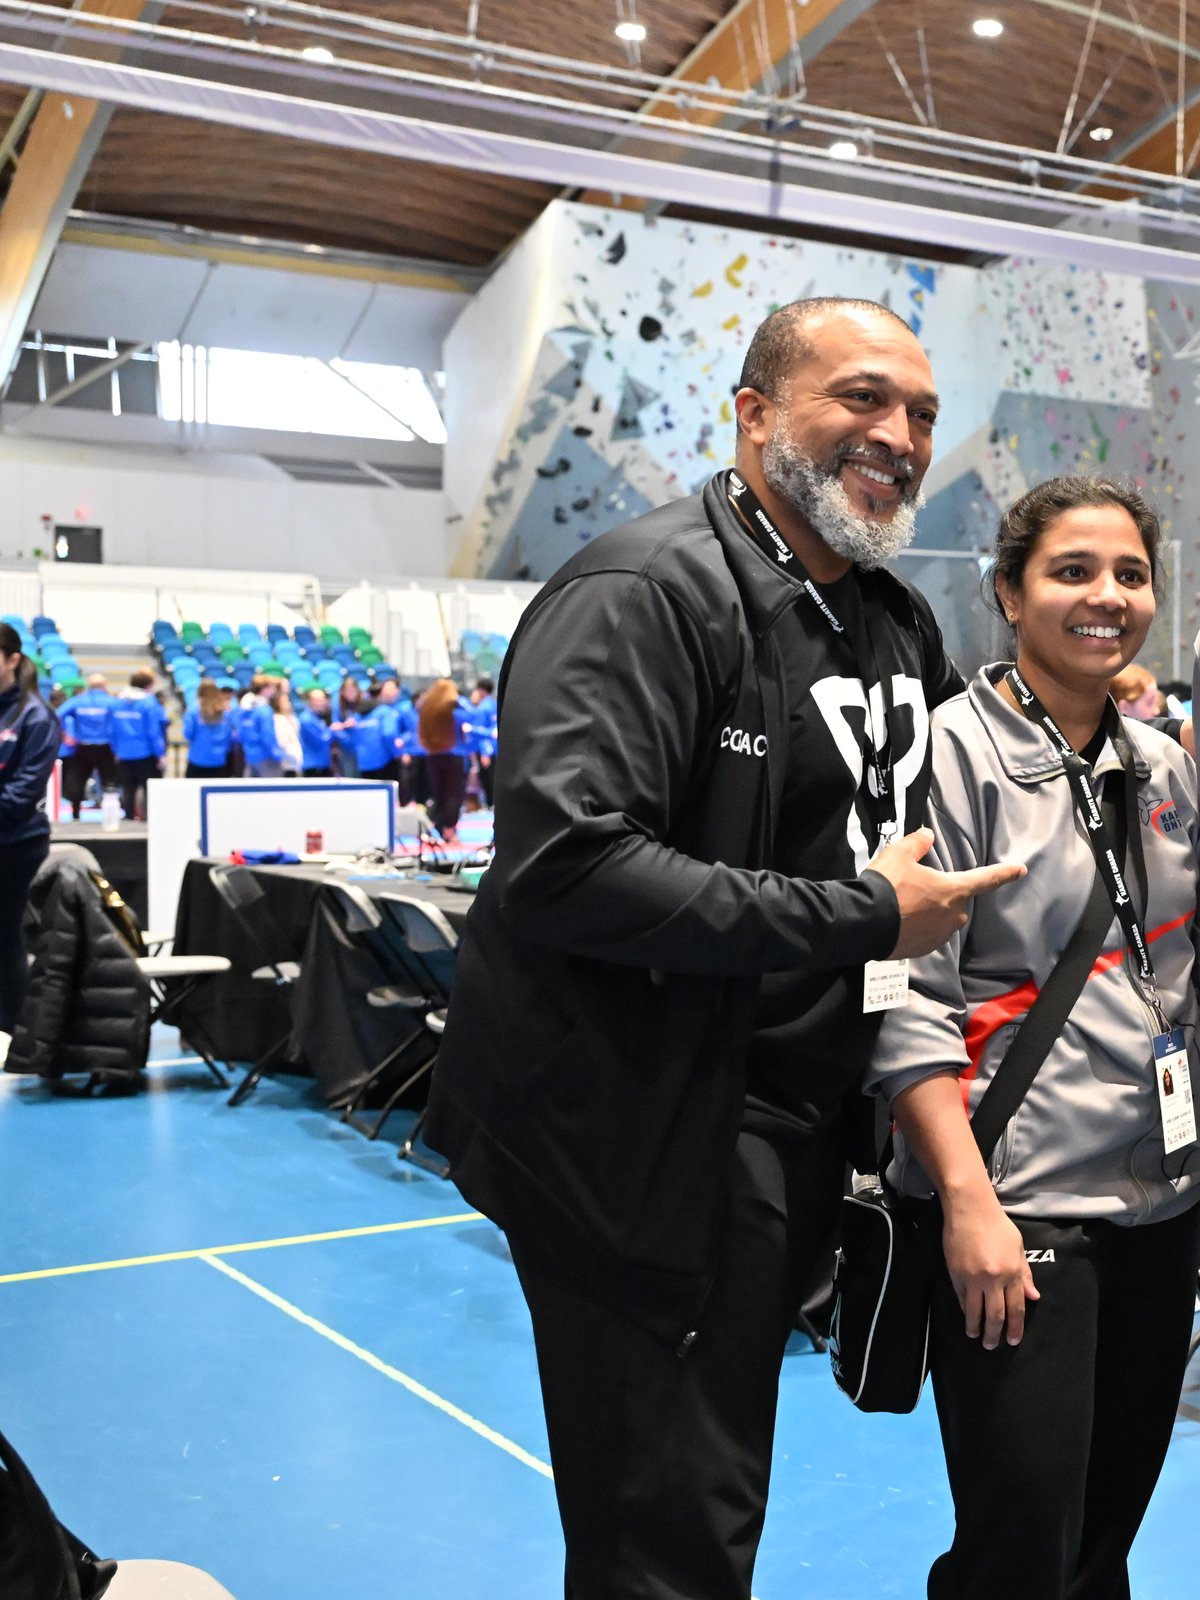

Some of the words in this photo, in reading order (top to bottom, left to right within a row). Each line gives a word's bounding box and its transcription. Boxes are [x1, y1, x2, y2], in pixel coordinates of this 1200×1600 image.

[770, 531, 789, 554] KARATE
[803, 579, 822, 605] CANADA
[820, 603, 840, 626] KARATE
[720, 726, 767, 757] COAC
[1087, 798, 1101, 822] KARATE
[1114, 873, 1128, 897] KARATE
[1024, 1249, 1056, 1263] ZA
